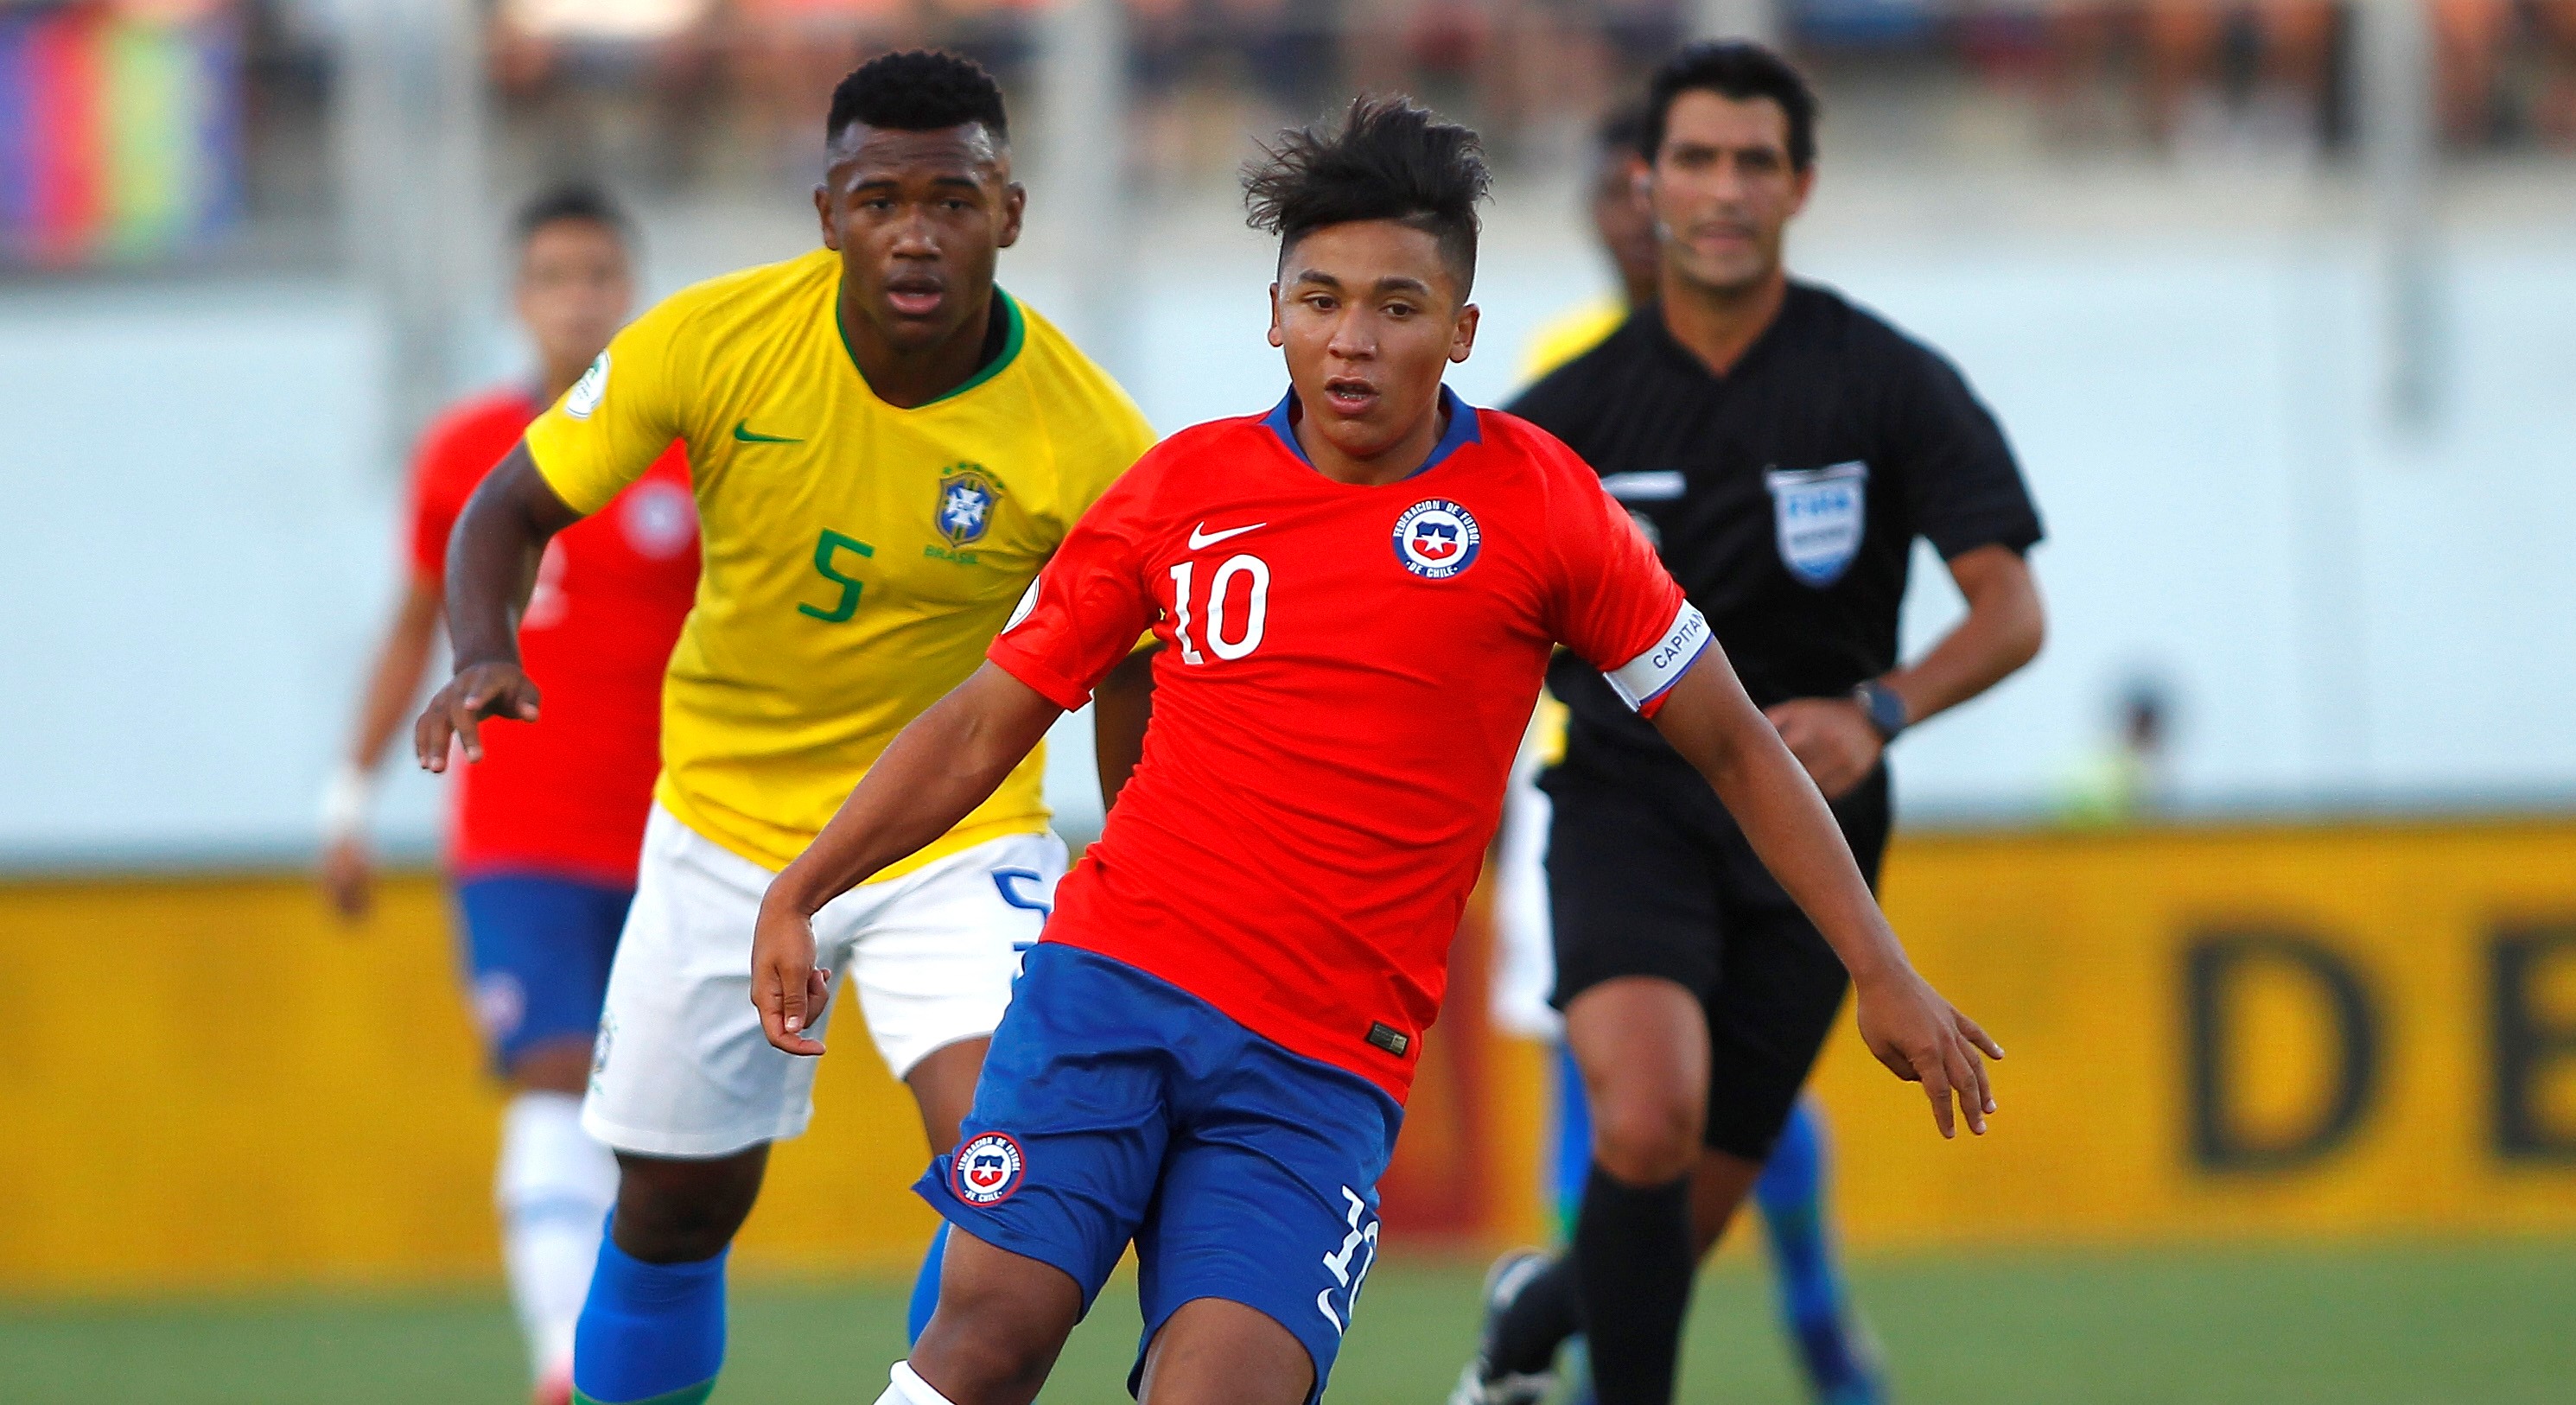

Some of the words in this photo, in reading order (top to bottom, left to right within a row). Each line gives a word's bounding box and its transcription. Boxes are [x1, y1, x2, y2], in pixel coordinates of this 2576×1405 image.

[1393, 500, 1441, 537] FEDERACION
[1445, 502, 1460, 515] DE
[1459, 512, 1480, 545] FUTBOL
[797, 528, 875, 623] 5
[1408, 562, 1423, 575] DE
[1426, 566, 1456, 578] CHILE
[1170, 554, 1270, 664] 10
